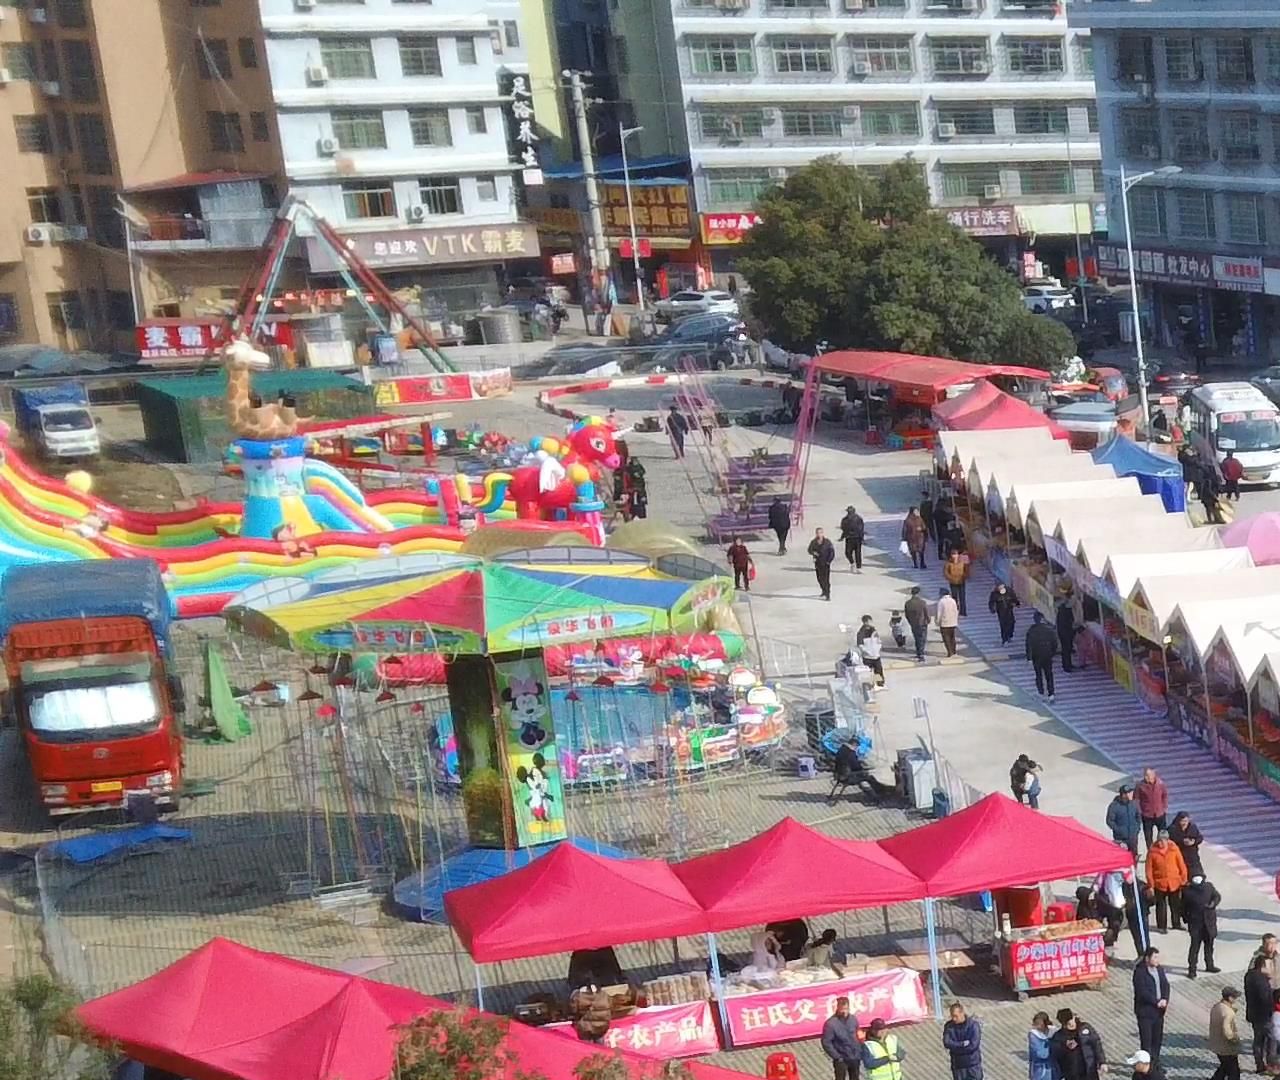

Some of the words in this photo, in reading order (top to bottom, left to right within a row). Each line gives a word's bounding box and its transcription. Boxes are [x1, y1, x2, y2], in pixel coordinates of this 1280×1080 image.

[740, 982, 917, 1031] 汪氏父子农产
